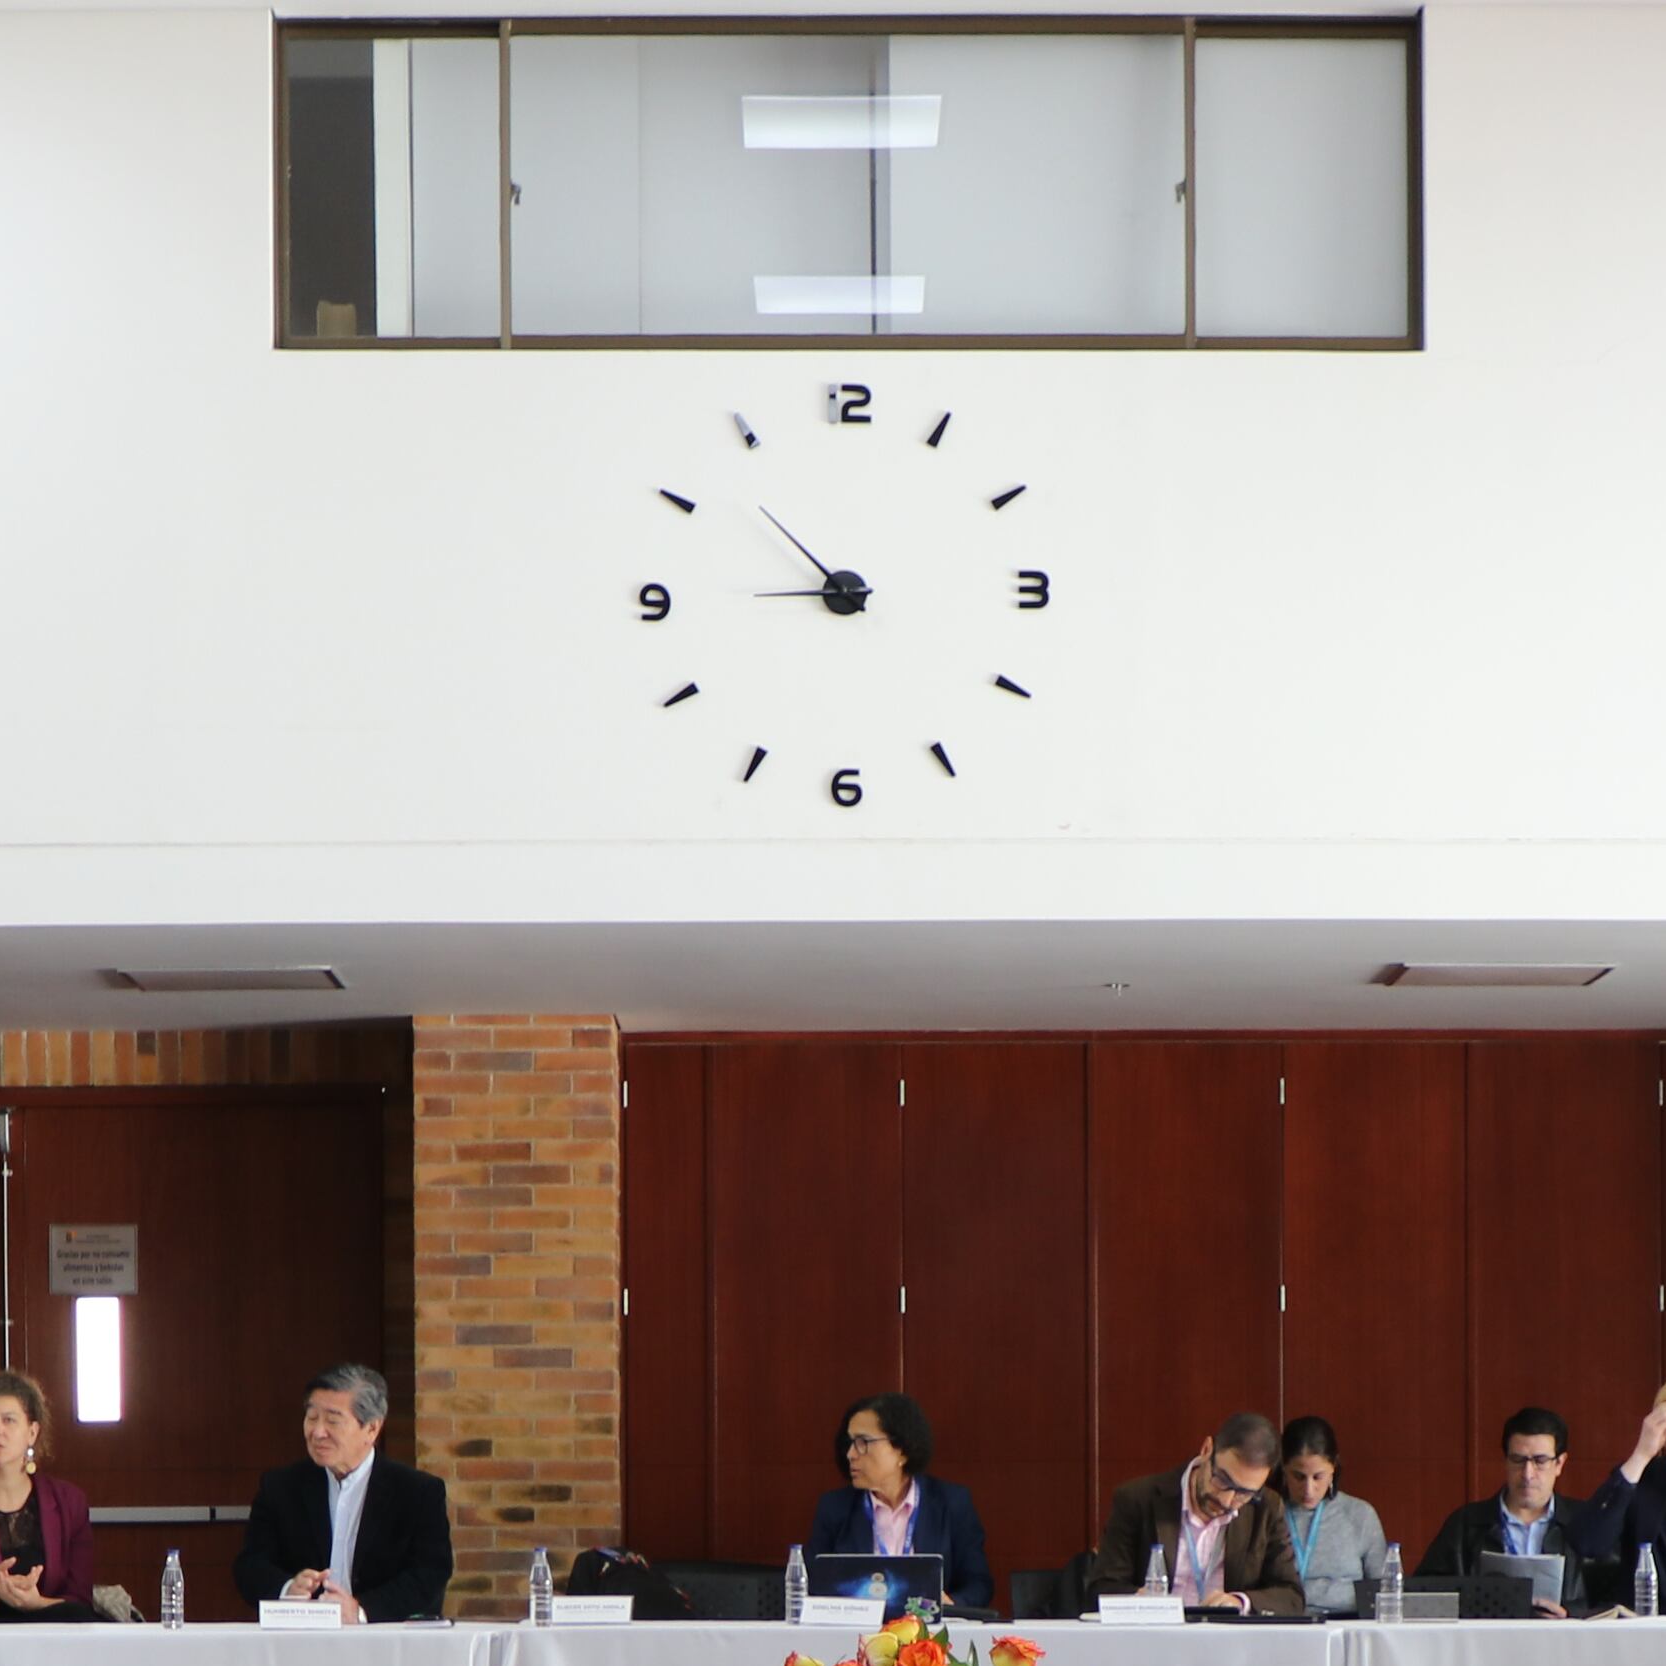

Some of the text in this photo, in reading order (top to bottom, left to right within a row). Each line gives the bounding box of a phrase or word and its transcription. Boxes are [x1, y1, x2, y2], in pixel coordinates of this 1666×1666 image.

[639, 583, 671, 622] 9
[1017, 570, 1050, 609] 3
[831, 769, 863, 807] 6
